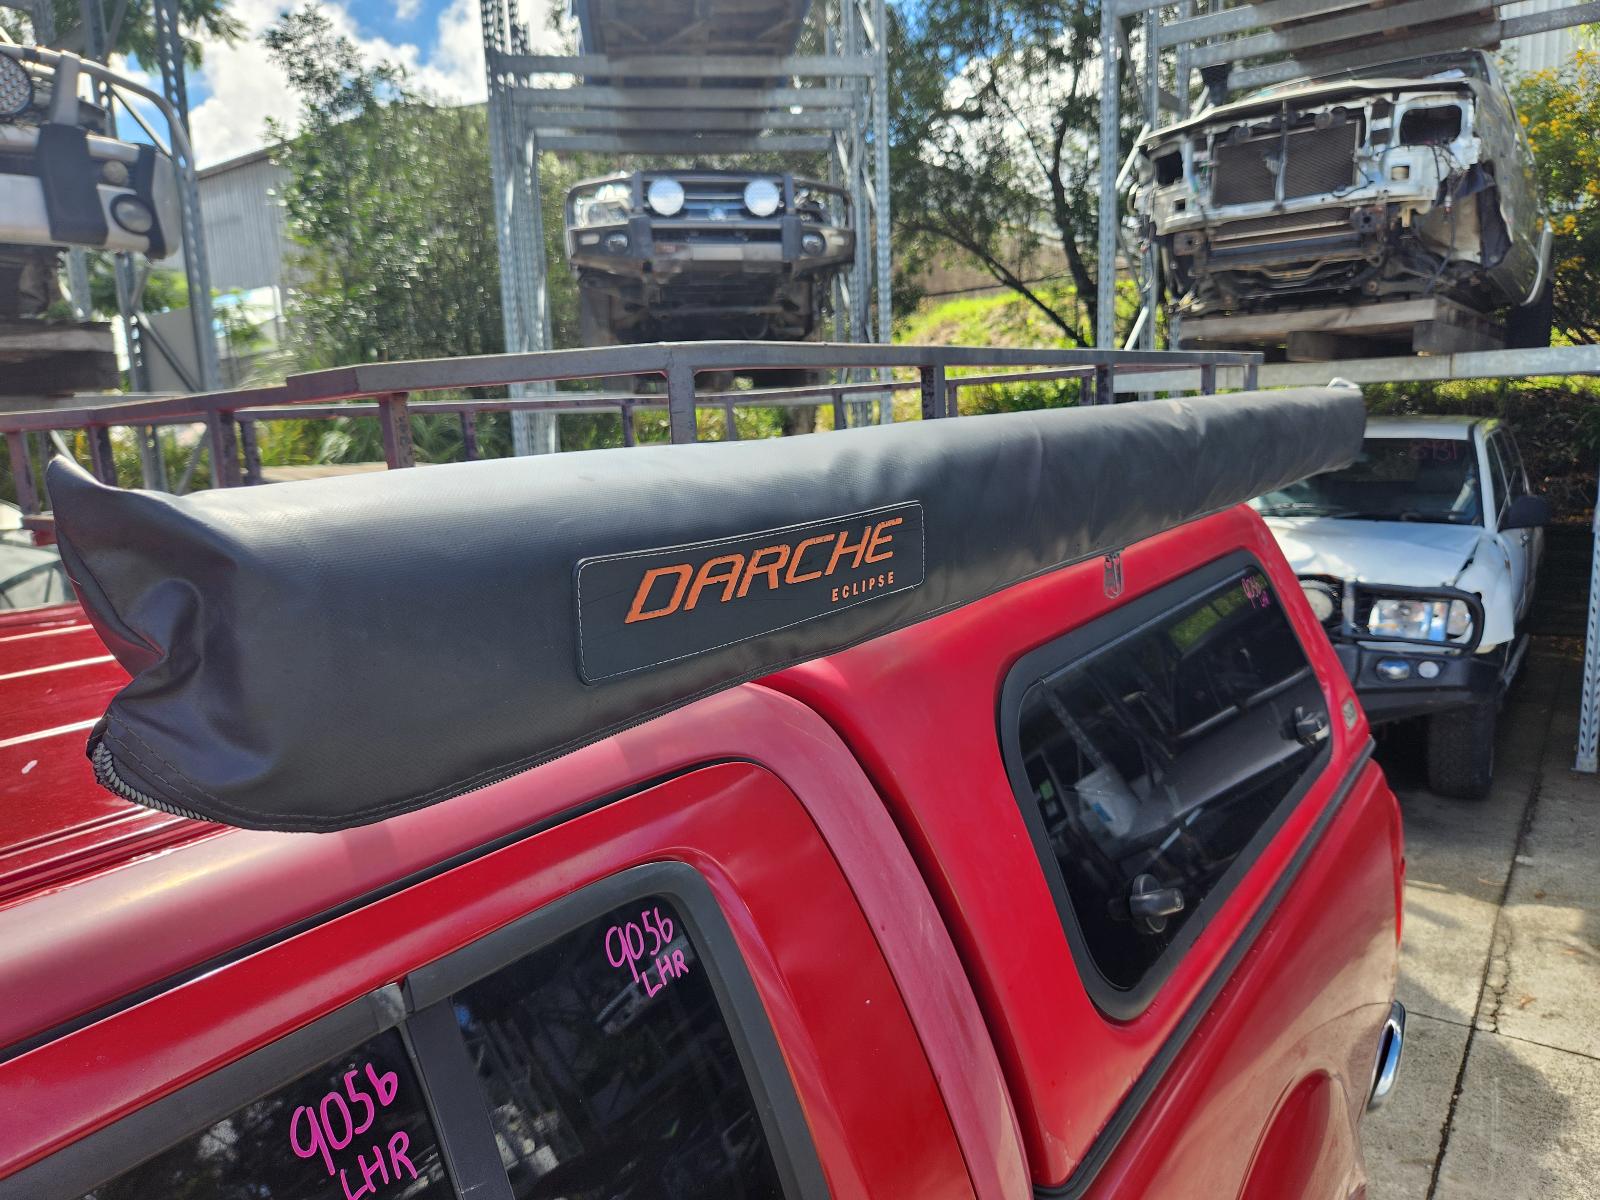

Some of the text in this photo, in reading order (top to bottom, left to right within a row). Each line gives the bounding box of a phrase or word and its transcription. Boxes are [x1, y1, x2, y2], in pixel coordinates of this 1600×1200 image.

[624, 517, 903, 624] DARCHE
[831, 571, 894, 602] ECLIPSE
[605, 907, 674, 983] 9056
[641, 949, 690, 998] LHR
[289, 1063, 399, 1176] 9056
[339, 1131, 418, 1200] LHR
